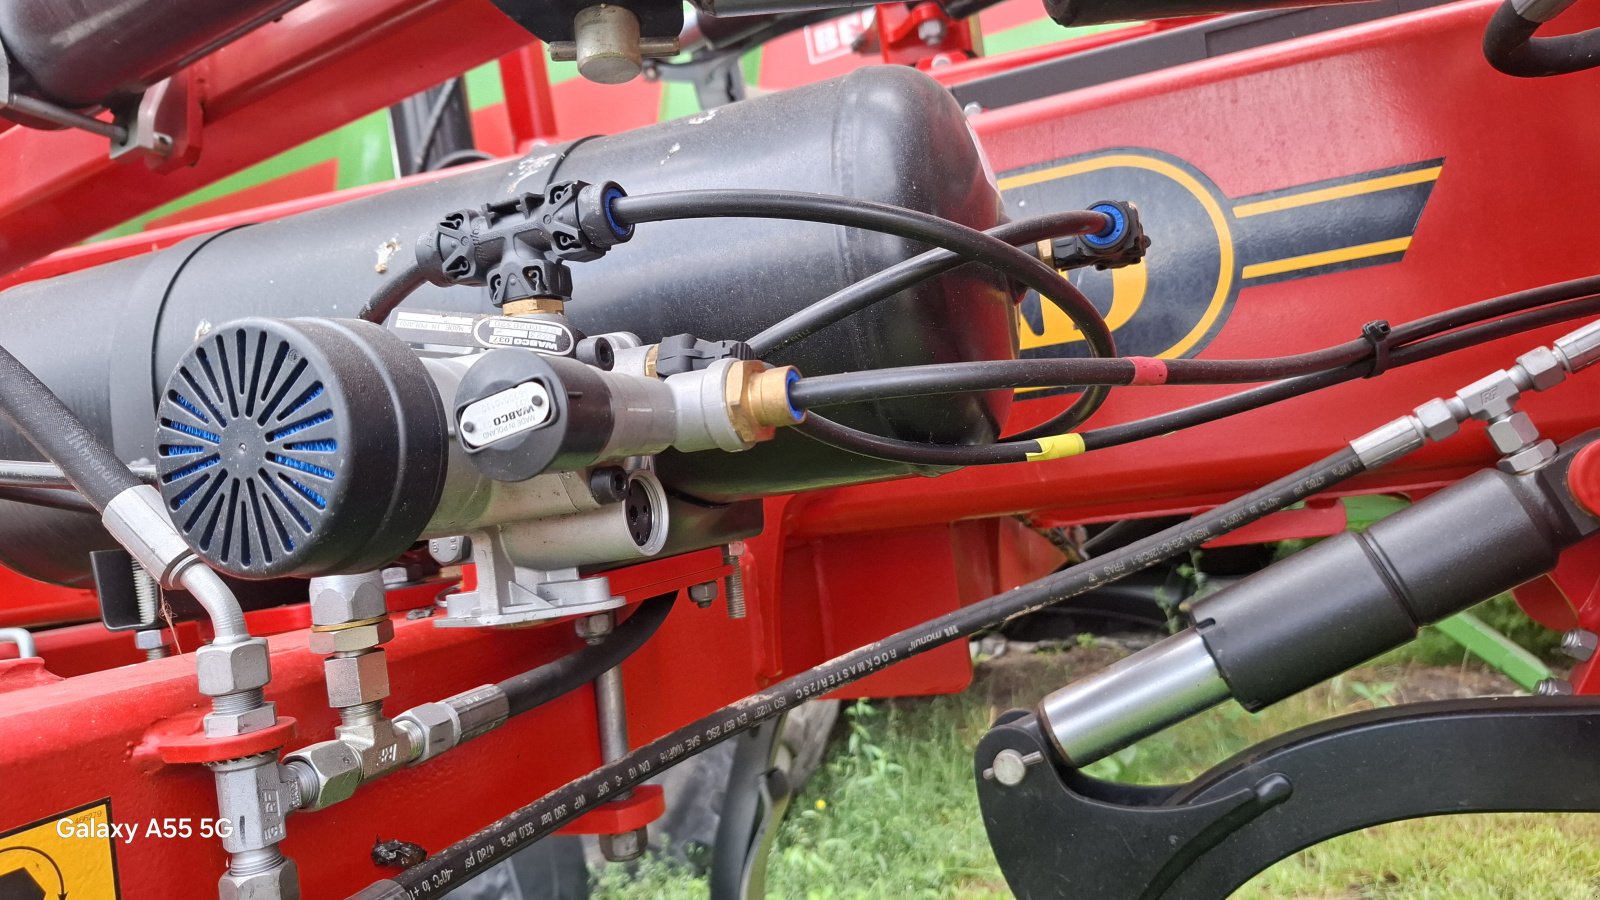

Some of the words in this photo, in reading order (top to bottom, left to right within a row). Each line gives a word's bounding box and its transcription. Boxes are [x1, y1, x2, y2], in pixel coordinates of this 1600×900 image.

[514, 338, 557, 350] WABCO
[494, 406, 534, 425] WABCO
[515, 414, 536, 426] MADE
[482, 425, 508, 439] POLAND
[1330, 460, 1351, 476] MPa
[1185, 524, 1210, 542] MSHA
[1103, 558, 1125, 576] FRAS
[792, 649, 896, 698] ROCKMASTER/2SC
[774, 696, 786, 708] ISO
[735, 712, 748, 724] EN
[706, 726, 720, 740] 2SC
[685, 735, 700, 750] SAE
[629, 767, 636, 778] 10
[639, 760, 650, 772] DN
[575, 794, 585, 809] WP
[541, 812, 552, 825] bar
[554, 804, 566, 819] 330
[519, 822, 534, 838] 33.0
[500, 831, 516, 846] MPa
[465, 852, 475, 868] psi
[422, 880, 430, 891] to
[433, 869, 453, 888] -40°C
